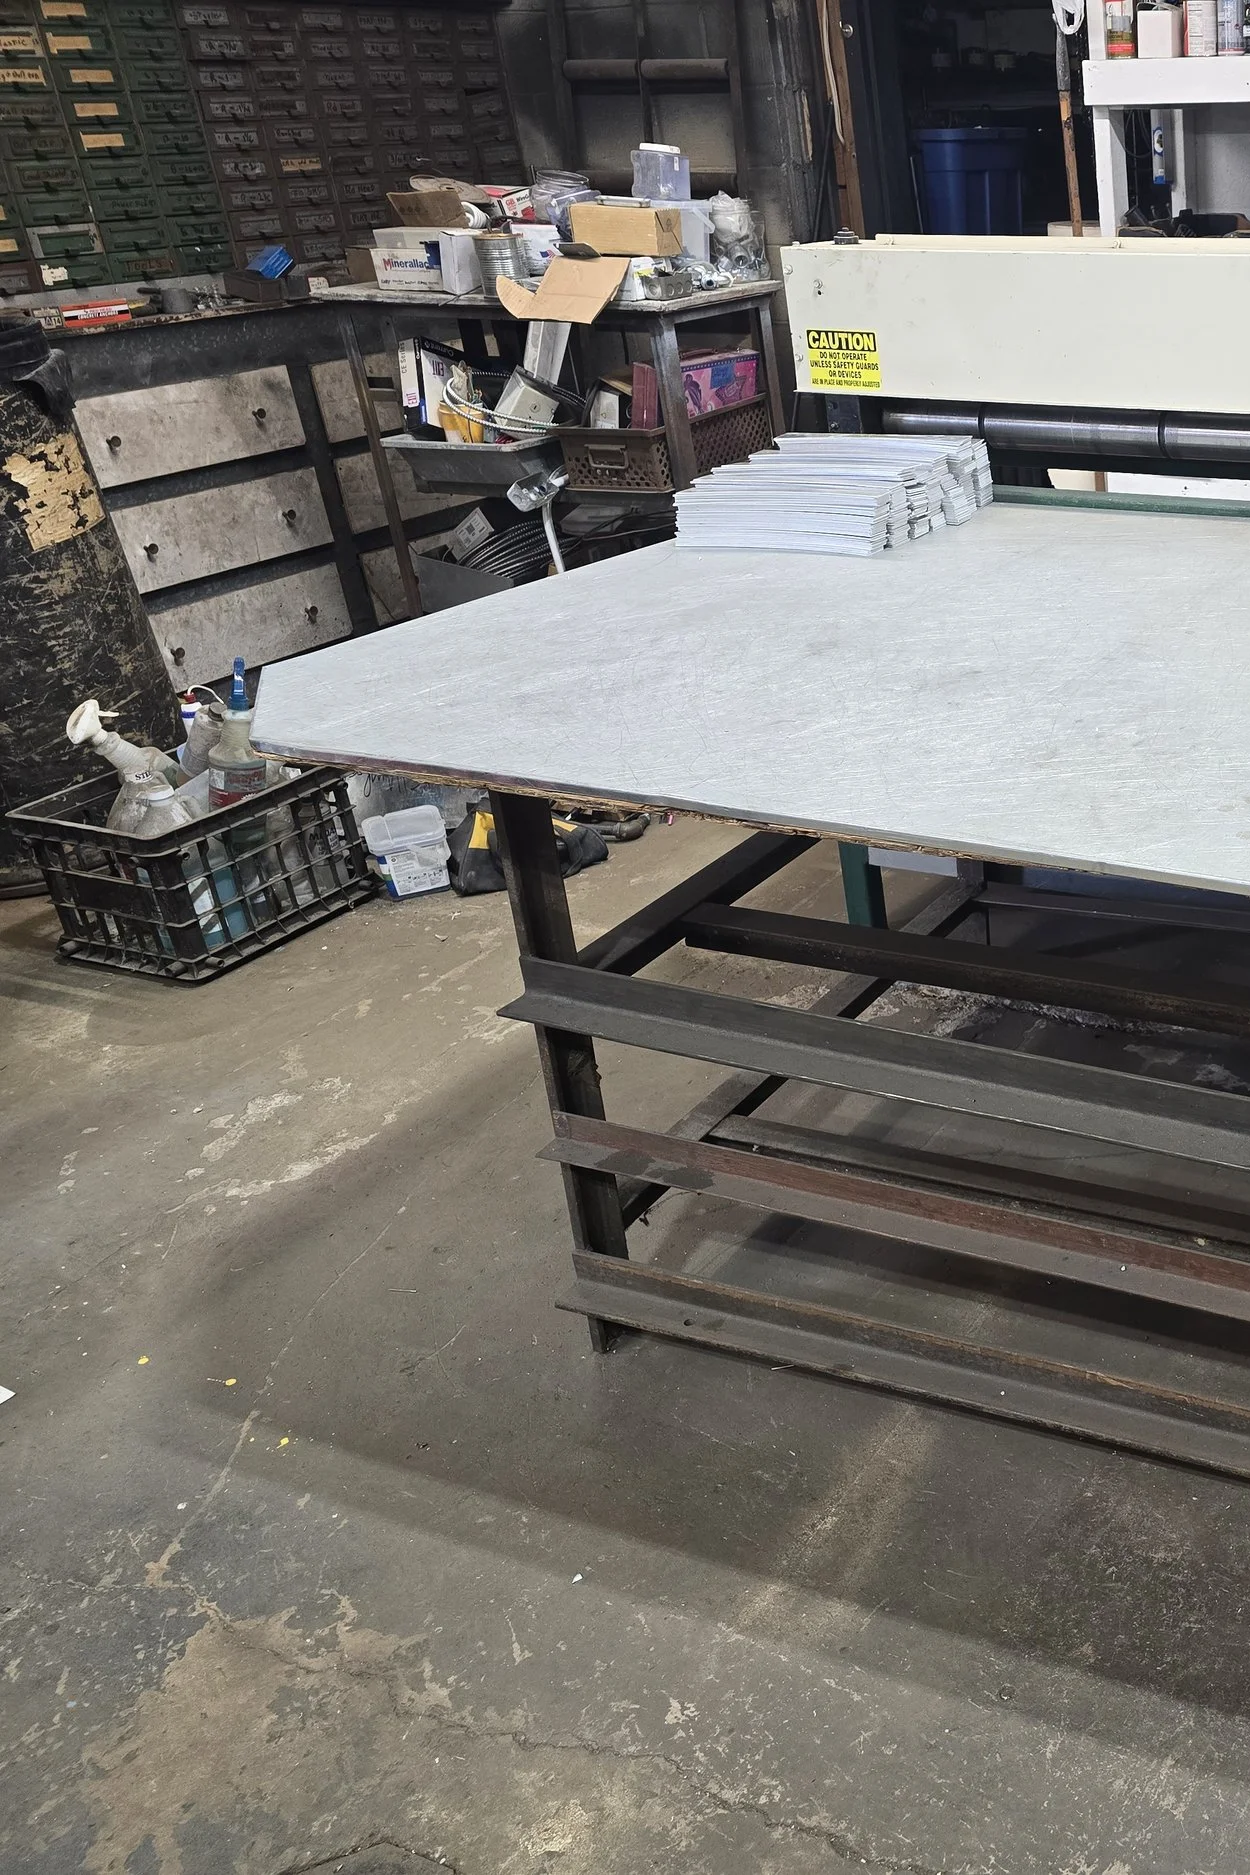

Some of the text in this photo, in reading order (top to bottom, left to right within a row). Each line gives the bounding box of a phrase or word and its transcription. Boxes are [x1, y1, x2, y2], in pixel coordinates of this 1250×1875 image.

[382, 258, 430, 272] Minerallac
[808, 330, 876, 351] CAUTION
[819, 351, 868, 361] DO NOT OPERATE
[810, 360, 880, 371] UNLESS SAFETY GUARDS
[828, 370, 862, 379] OR DEVICES
